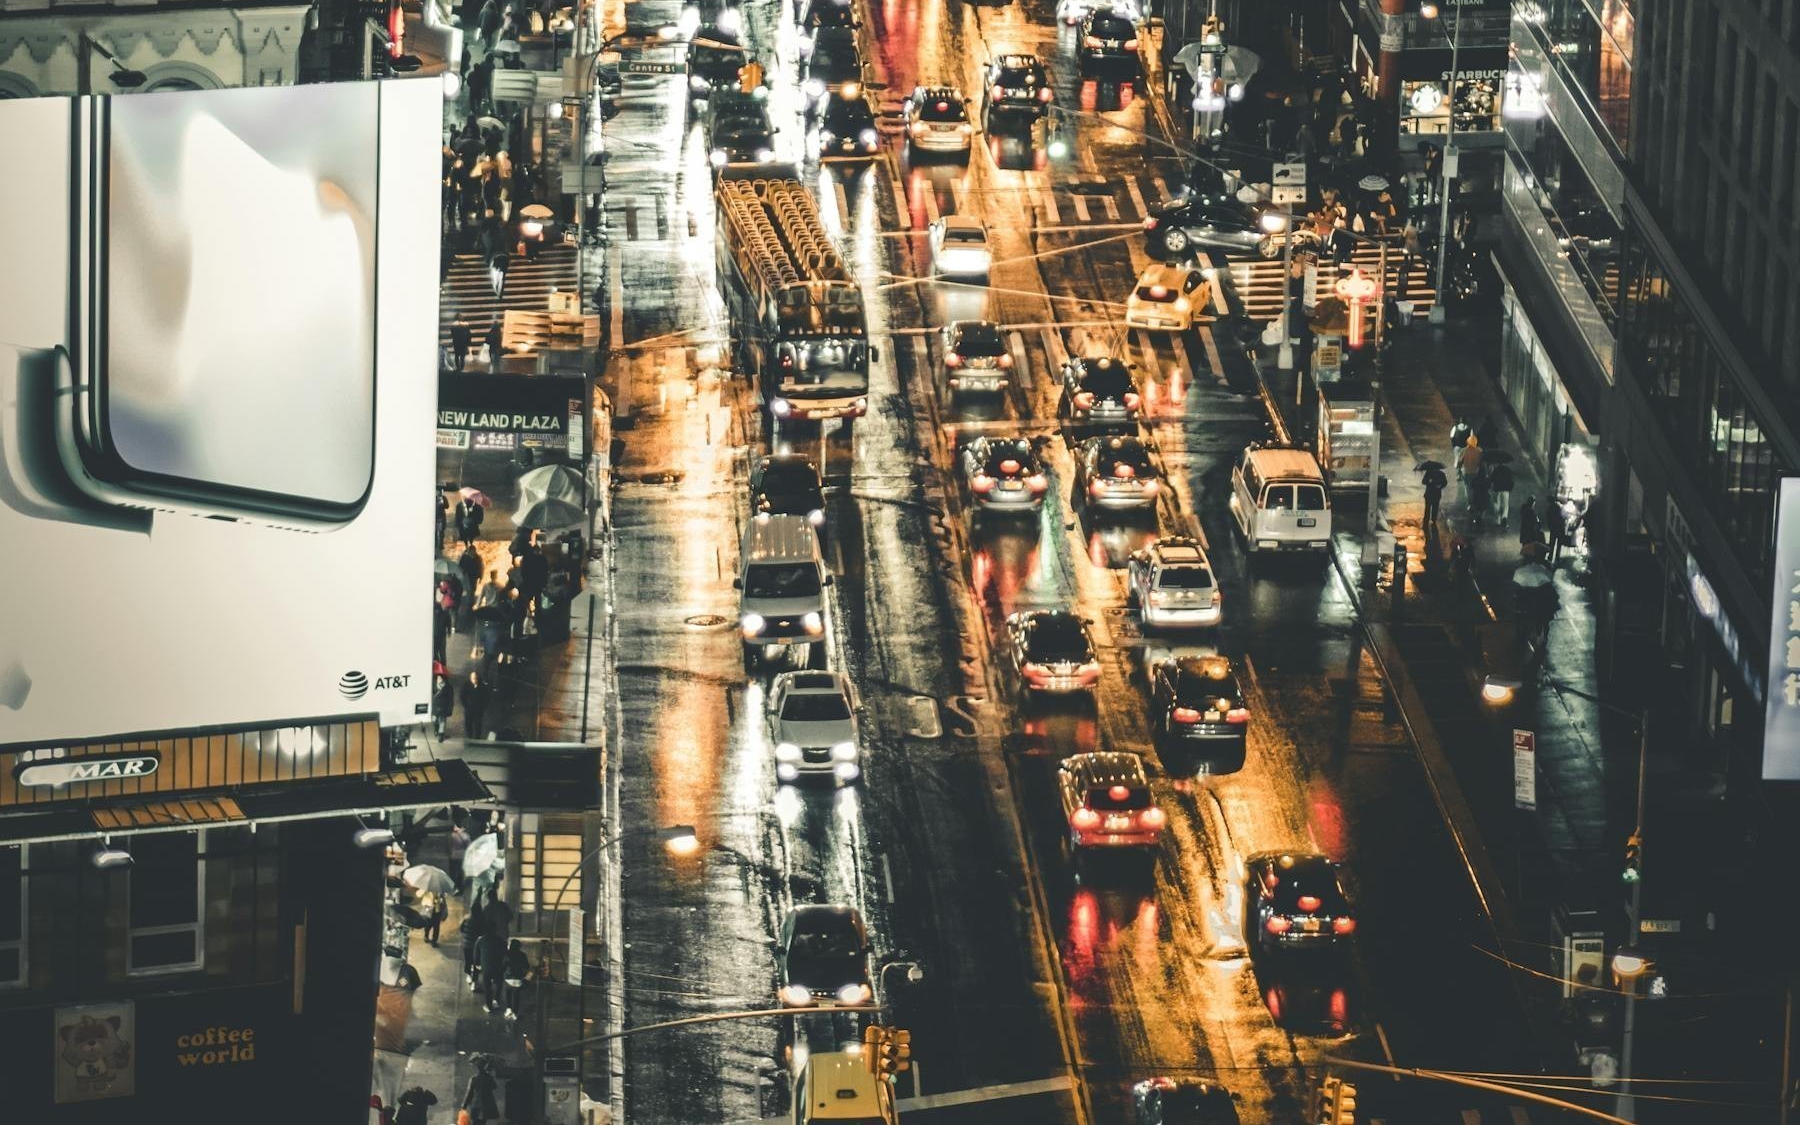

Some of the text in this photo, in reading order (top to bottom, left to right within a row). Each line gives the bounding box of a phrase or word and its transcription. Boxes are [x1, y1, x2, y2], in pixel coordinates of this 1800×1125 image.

[629, 63, 676, 73] Centre St
[1441, 70, 1508, 81] STARBUCK
[437, 410, 560, 430] NEW LAND PLAZA
[375, 675, 411, 690] AT&T
[177, 1026, 254, 1048] coffee
[177, 1043, 254, 1066] world
